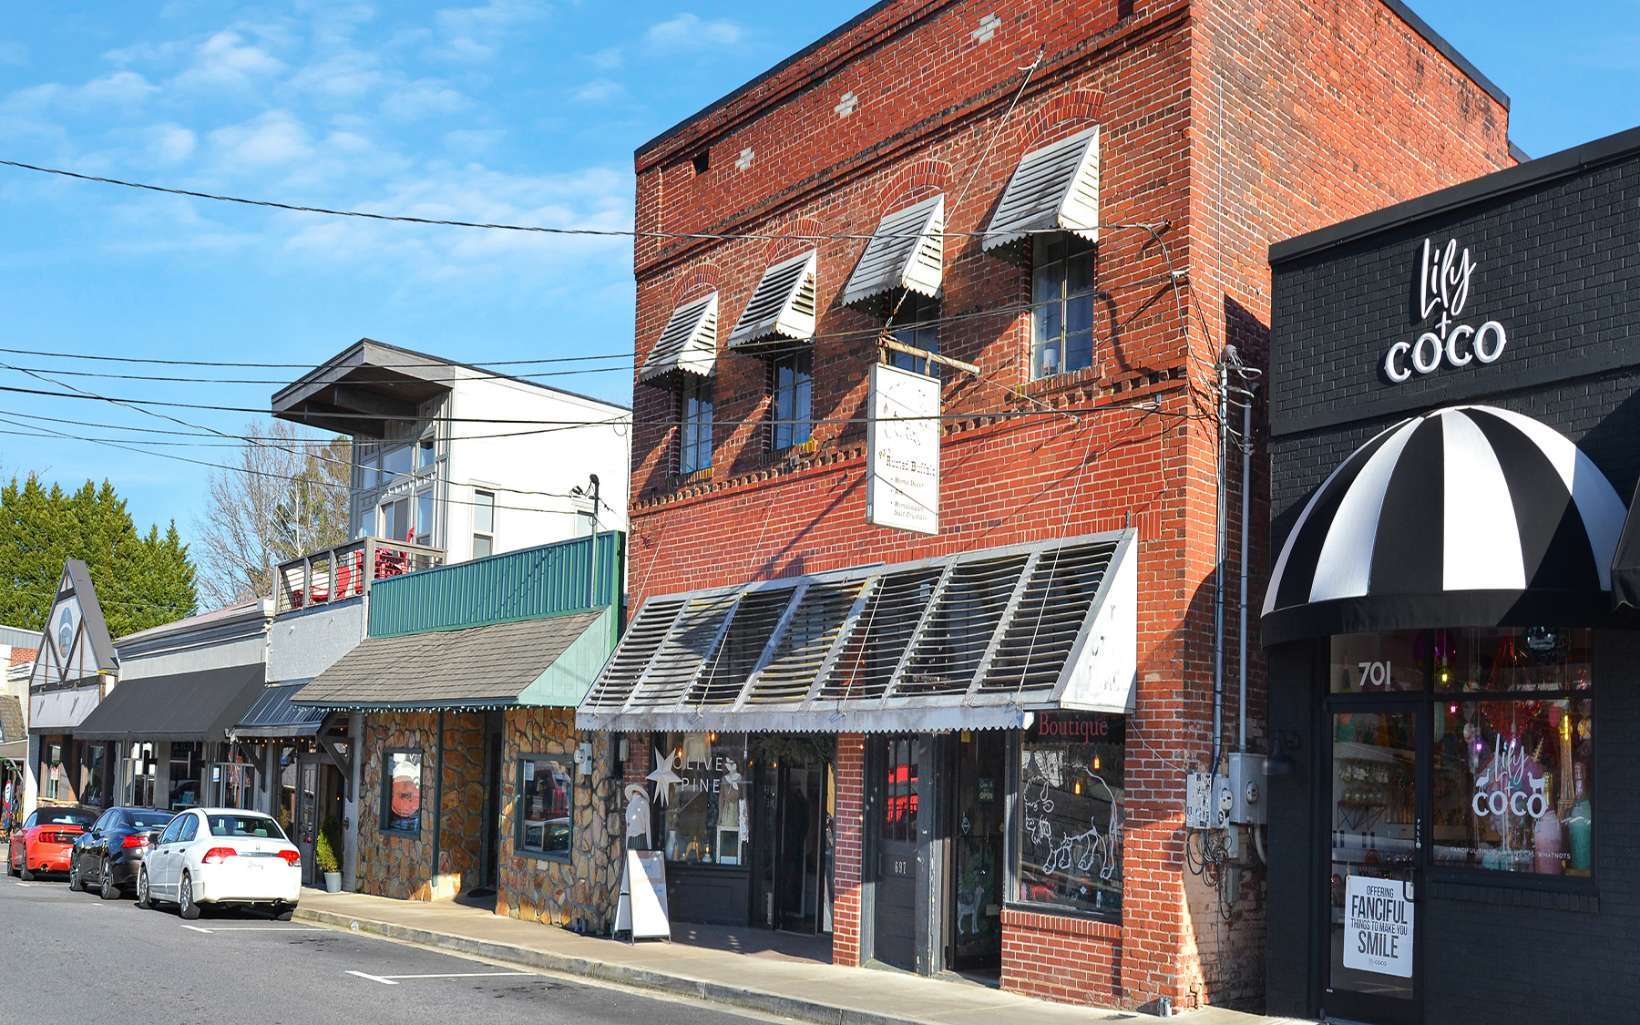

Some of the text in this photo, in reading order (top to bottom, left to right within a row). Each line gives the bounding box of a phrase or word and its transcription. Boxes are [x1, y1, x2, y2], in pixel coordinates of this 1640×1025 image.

[1384, 321, 1507, 383] COCO
[1358, 661, 1391, 686] 701
[1039, 712, 1109, 745] Boutique
[673, 756, 723, 771] OLIVE
[681, 777, 720, 793] PINE
[1472, 791, 1548, 818] COCO
[1366, 885, 1394, 898] OFFERING
[1351, 894, 1408, 925] FANCIFUL
[1351, 918, 1408, 936] THINGS TO MAKE YOU
[1358, 930, 1399, 959] SMILE
